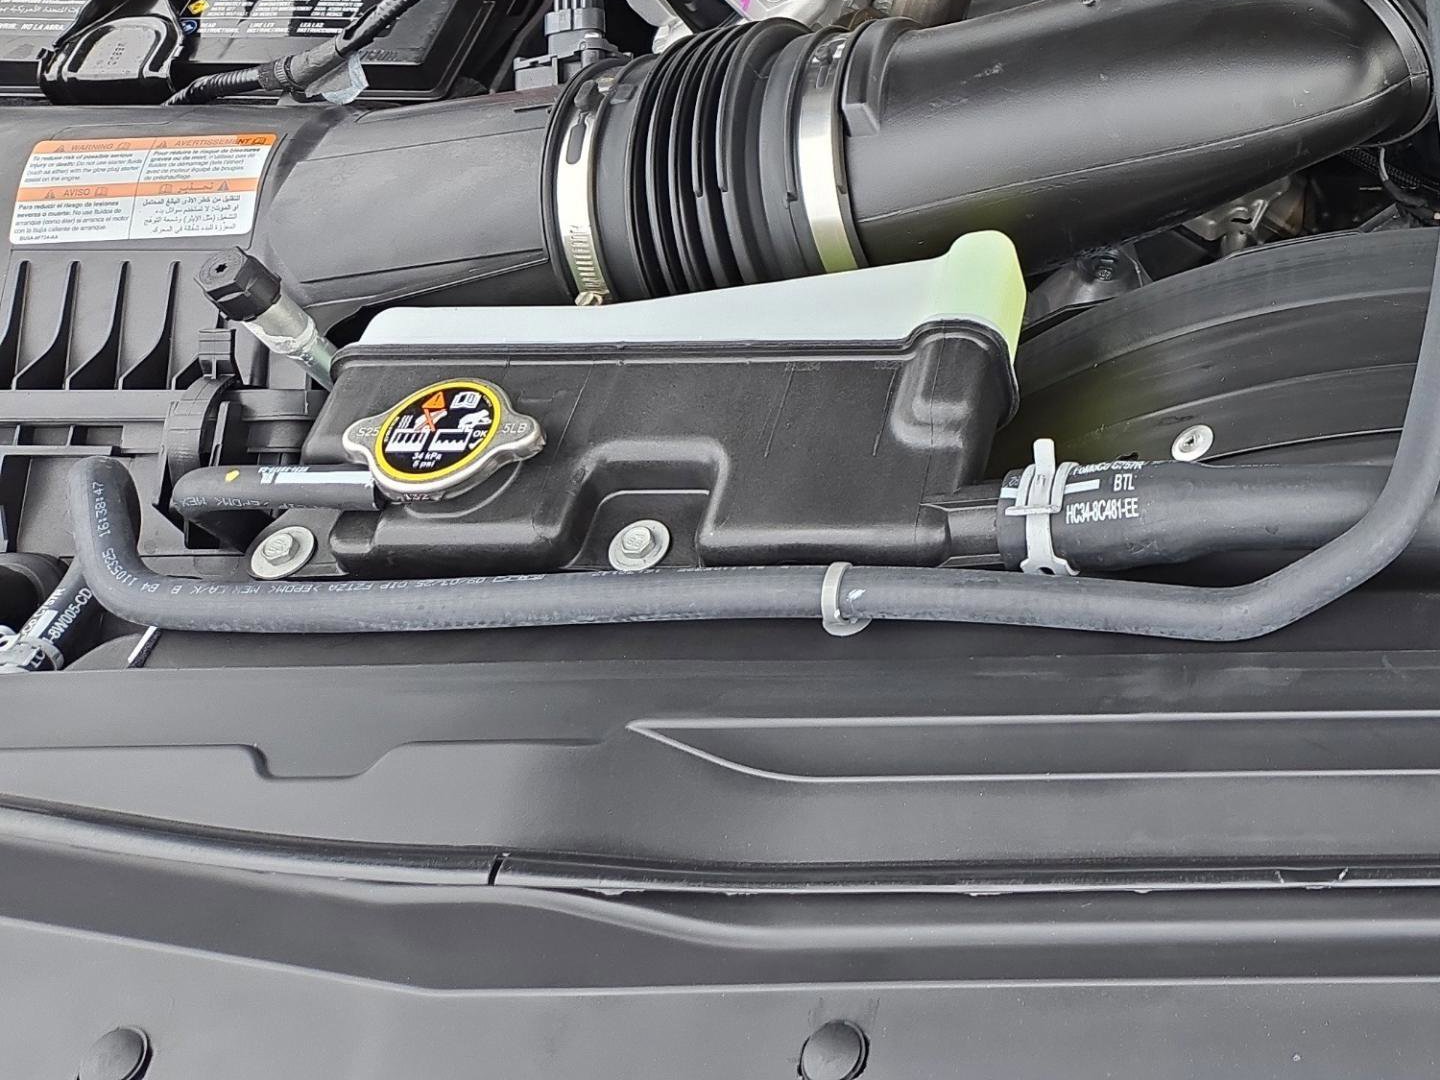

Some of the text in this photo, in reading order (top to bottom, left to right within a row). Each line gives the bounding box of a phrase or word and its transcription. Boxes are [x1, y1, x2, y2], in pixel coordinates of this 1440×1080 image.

[71, 143, 114, 151] WARNING
[63, 188, 89, 196] AVISO
[473, 429, 488, 438] OK
[412, 452, 424, 461] 34
[1113, 473, 1135, 492] BTL
